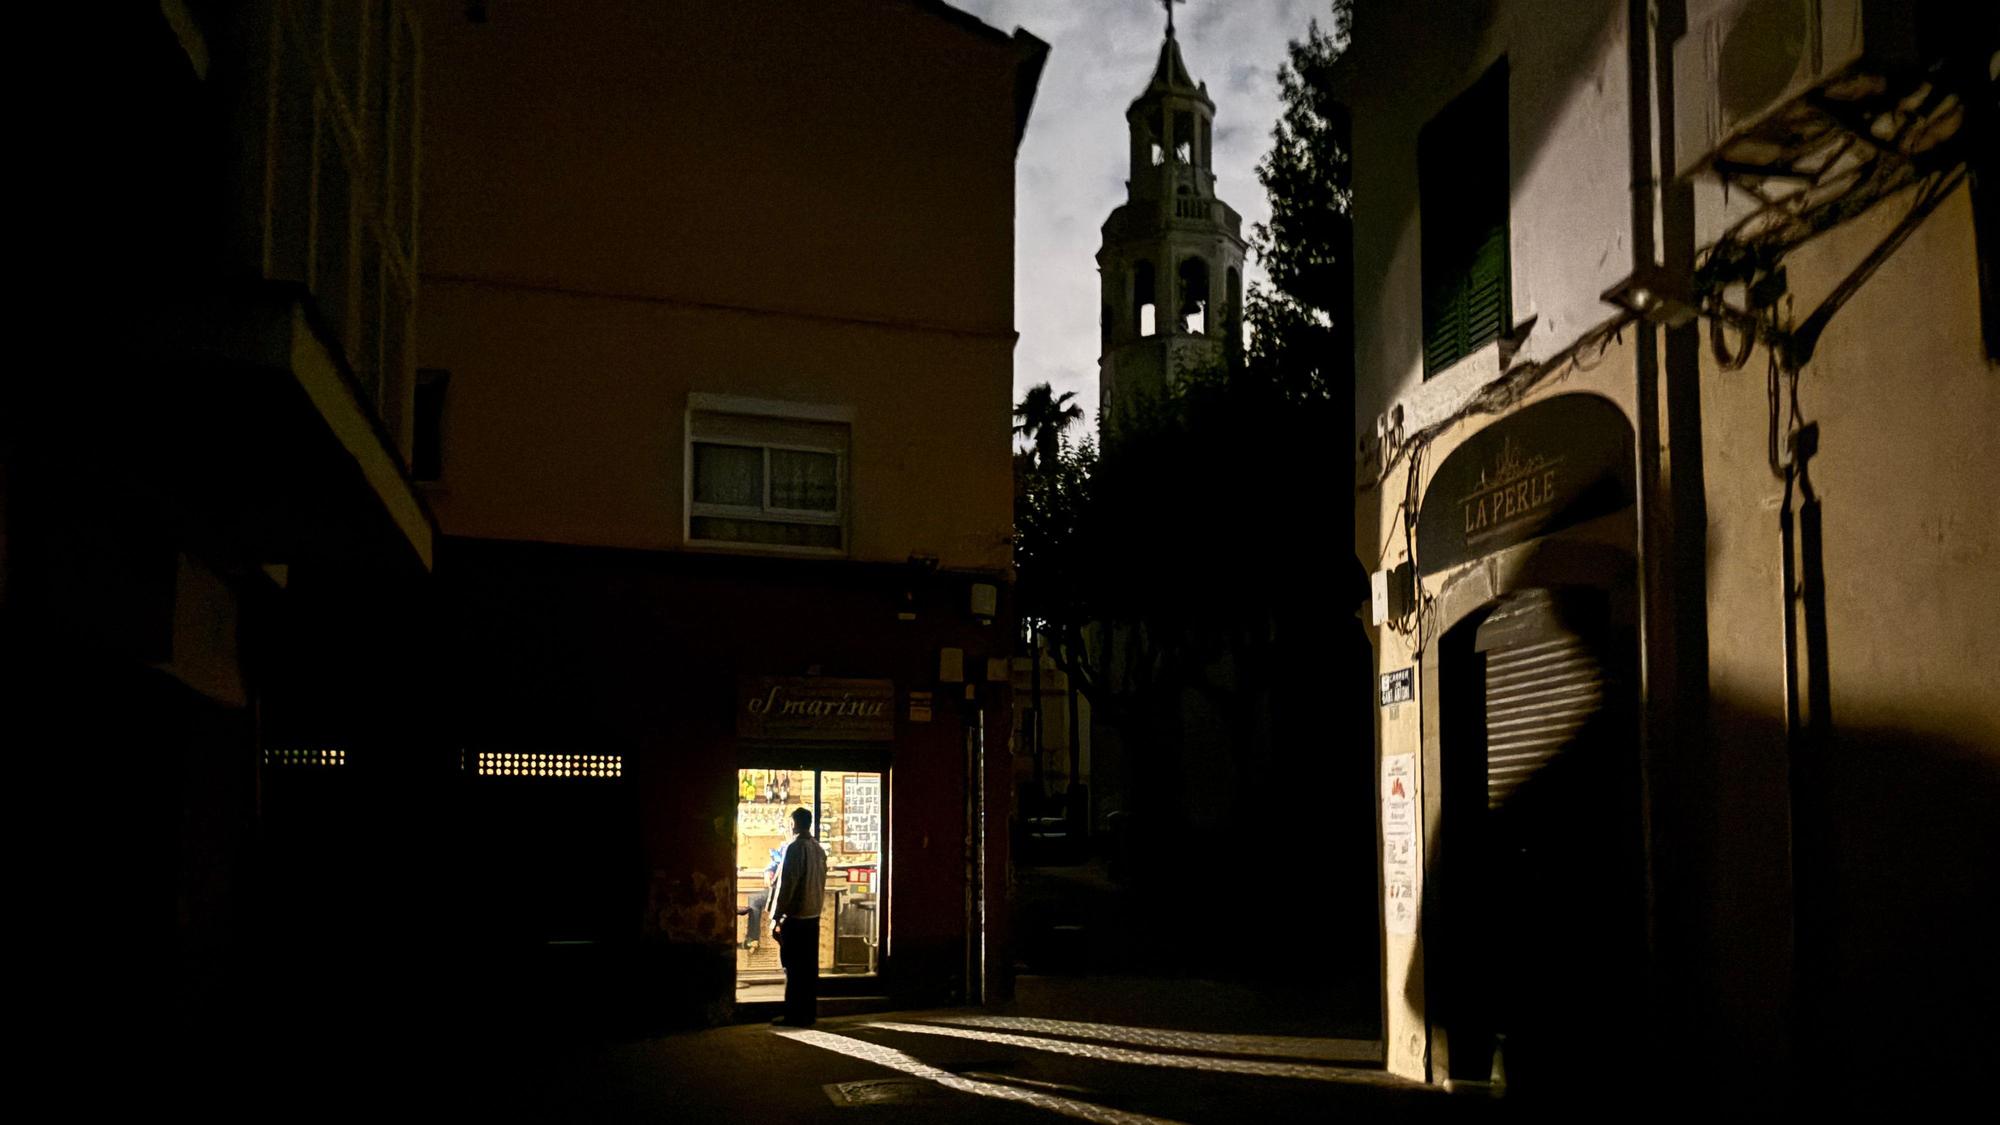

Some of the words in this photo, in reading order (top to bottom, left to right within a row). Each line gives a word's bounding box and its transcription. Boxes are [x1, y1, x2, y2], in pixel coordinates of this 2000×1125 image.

[1465, 498, 1487, 533] LA
[1493, 470, 1555, 524] PERLE
[782, 693, 885, 717] marina
